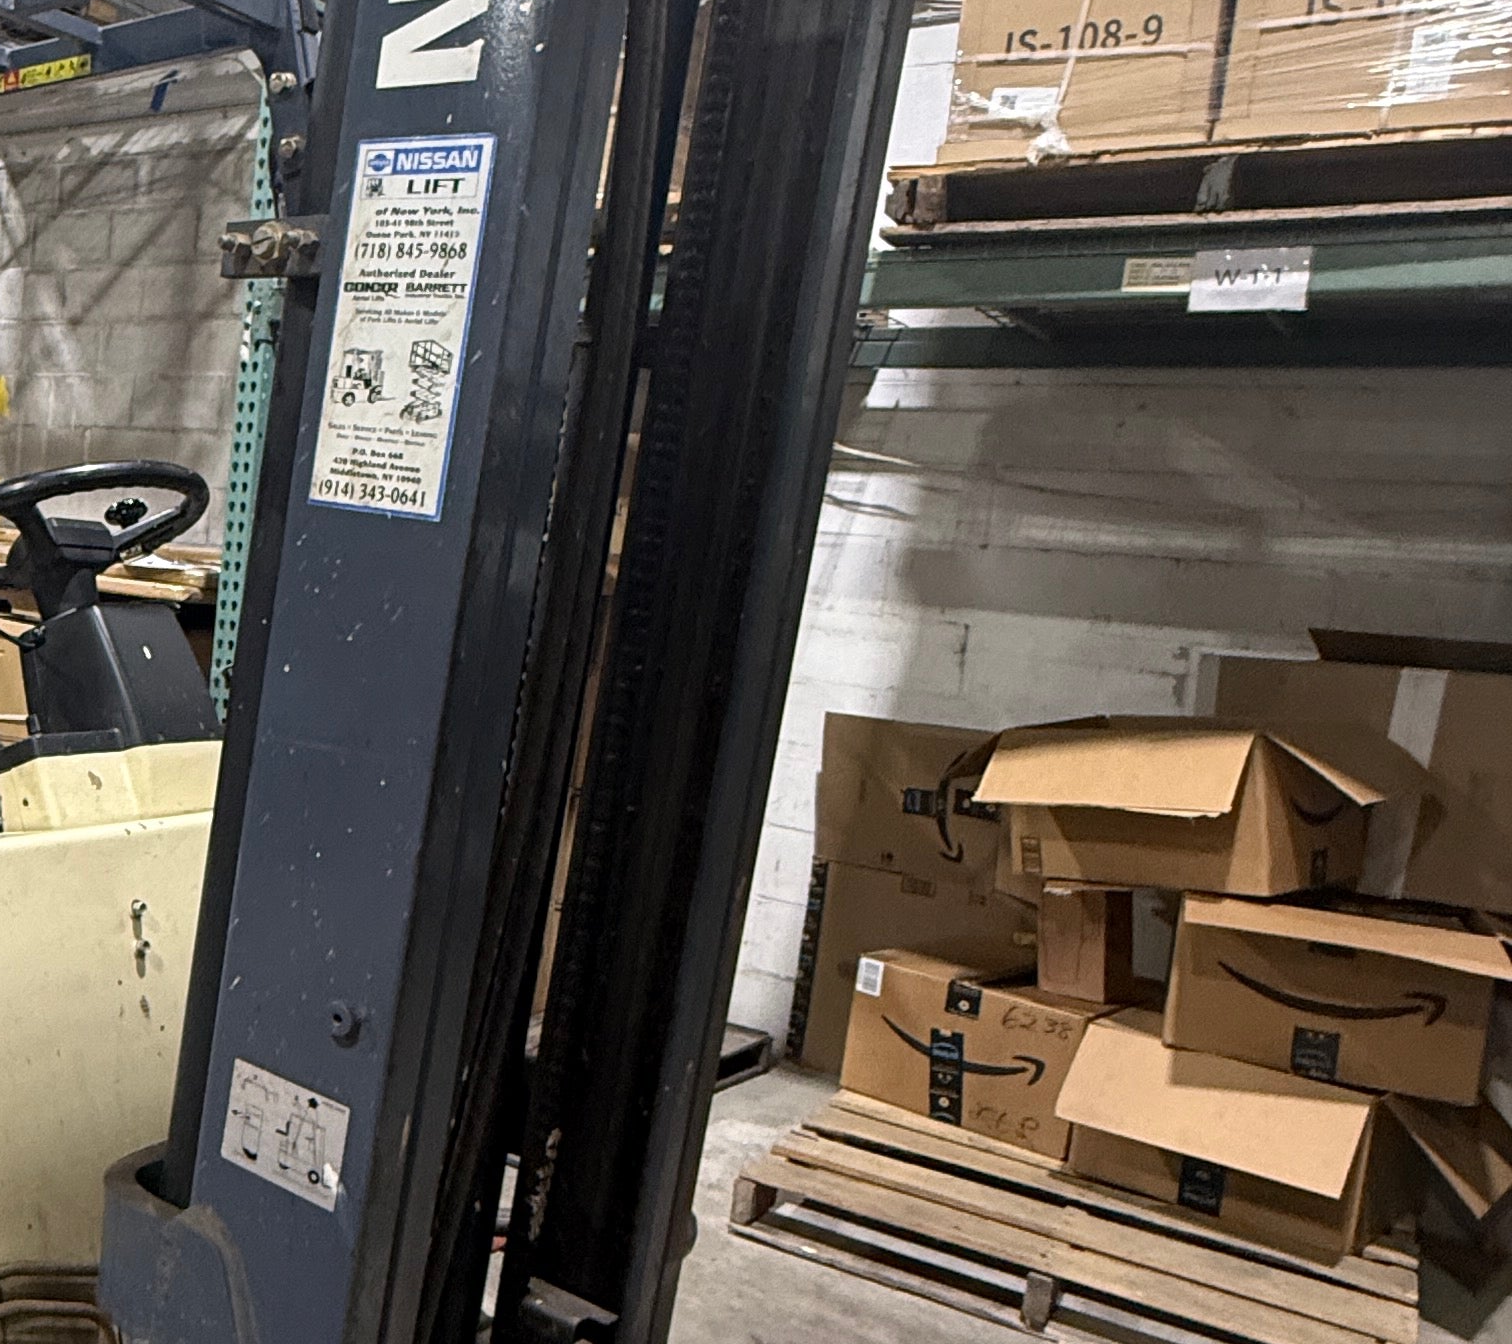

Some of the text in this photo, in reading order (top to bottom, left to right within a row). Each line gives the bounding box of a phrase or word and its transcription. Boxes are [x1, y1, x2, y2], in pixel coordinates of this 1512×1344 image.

[396, 148, 478, 170] NISSAN
[407, 177, 465, 195] LIFT
[375, 205, 480, 217] of New York, Inc.
[426, 219, 454, 227] Street
[419, 230, 431, 239] NY
[354, 241, 468, 261] (718) 845-9868
[419, 269, 456, 278] Dealer
[405, 282, 468, 293] BARRETT
[370, 449, 385, 458] Box
[349, 458, 387, 469] Highland
[389, 462, 421, 473] Avenue
[382, 473, 393, 482] NY
[318, 479, 426, 507] (914) 343-0641
